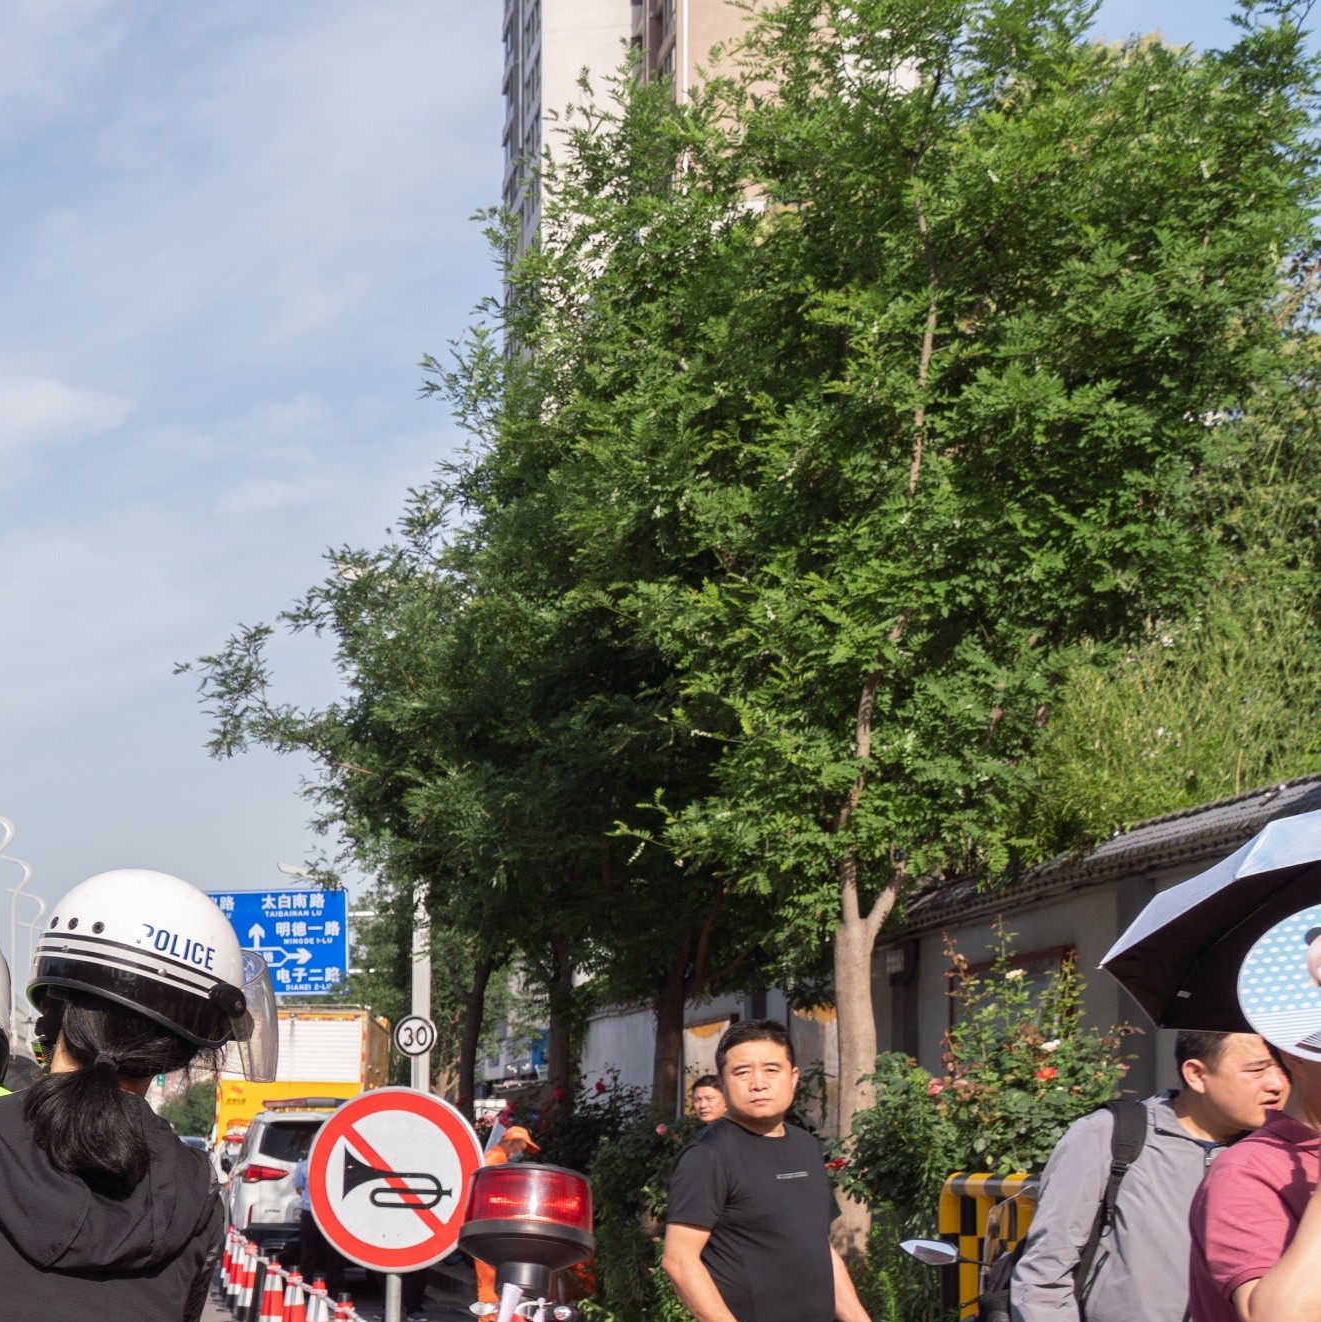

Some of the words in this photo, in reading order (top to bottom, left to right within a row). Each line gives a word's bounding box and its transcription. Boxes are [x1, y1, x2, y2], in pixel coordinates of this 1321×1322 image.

[261, 893, 325, 910] 太白南路
[275, 920, 340, 938] 明德一路
[276, 966, 340, 984] 电子二路
[403, 1026, 427, 1047] 30
